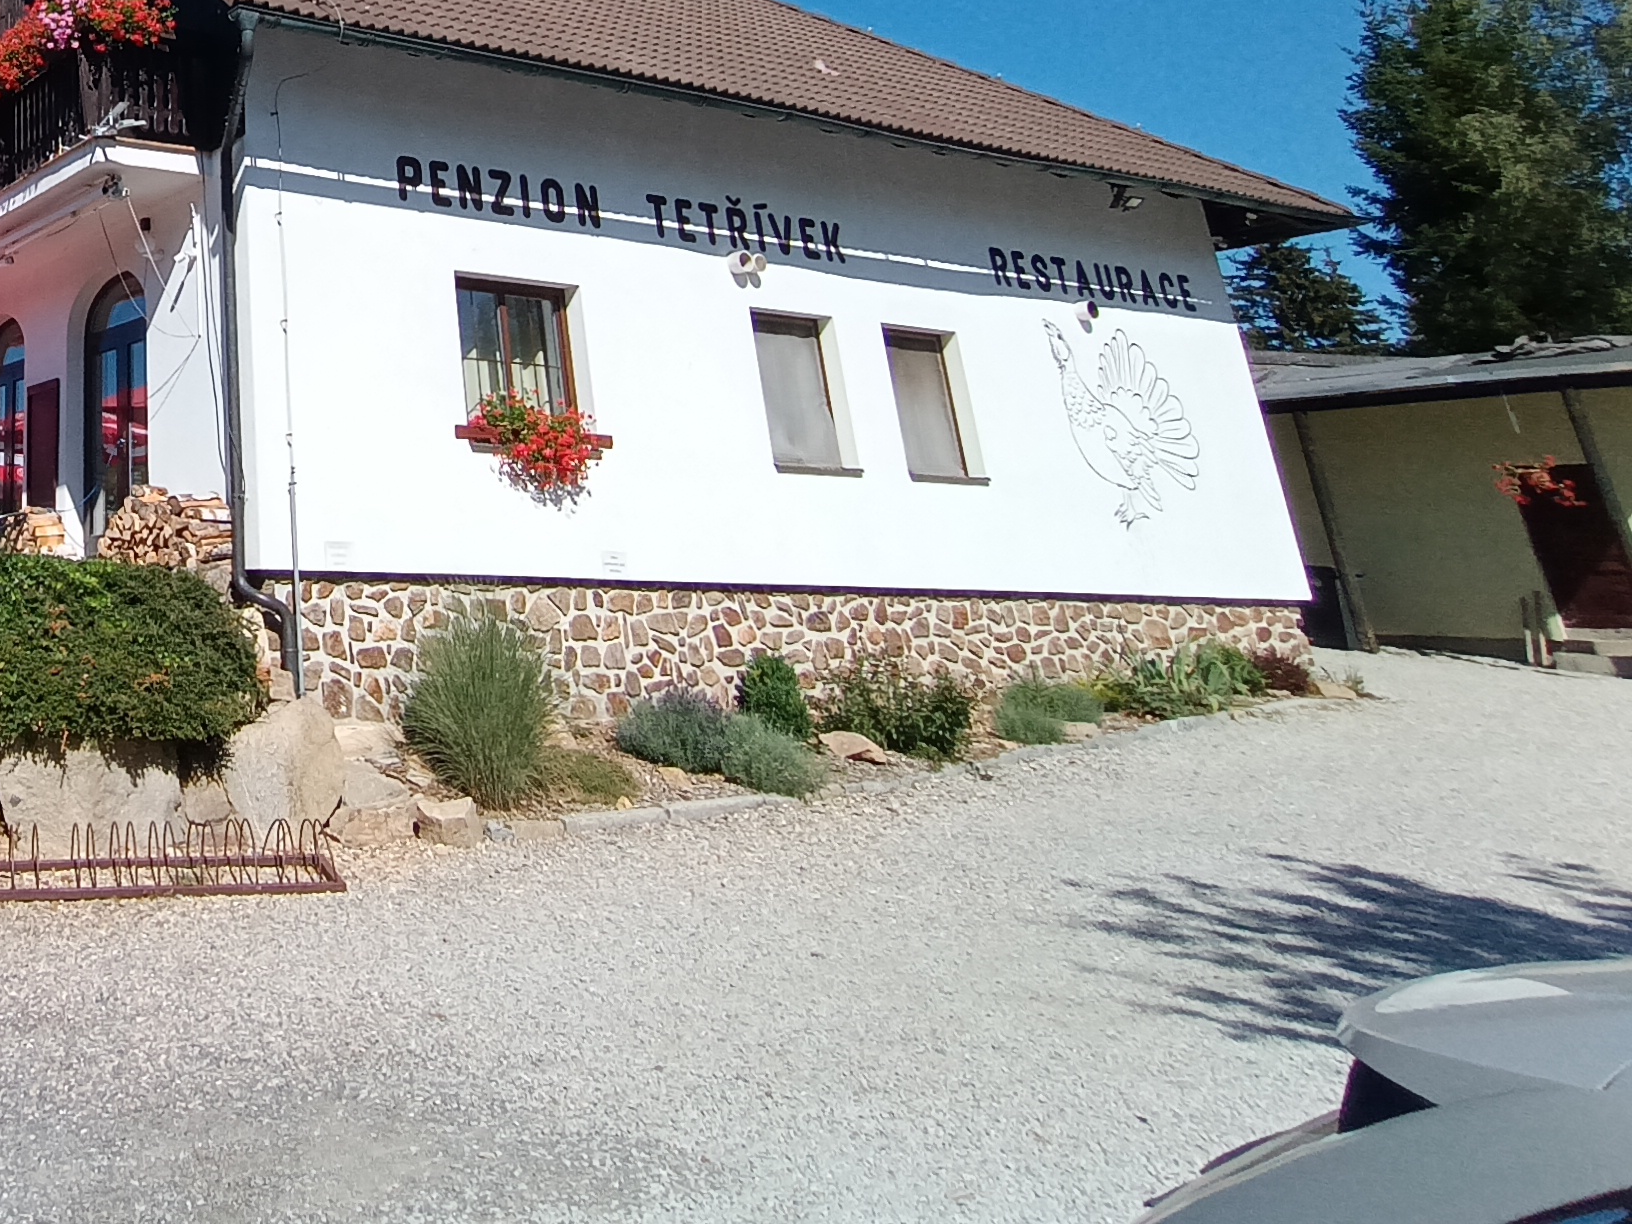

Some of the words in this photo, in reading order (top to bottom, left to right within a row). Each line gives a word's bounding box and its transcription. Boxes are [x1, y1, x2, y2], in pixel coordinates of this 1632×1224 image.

[396, 155, 601, 229] PENZION
[646, 194, 846, 263] TETŘÍVEK
[988, 246, 1197, 312] RESTAURACE
